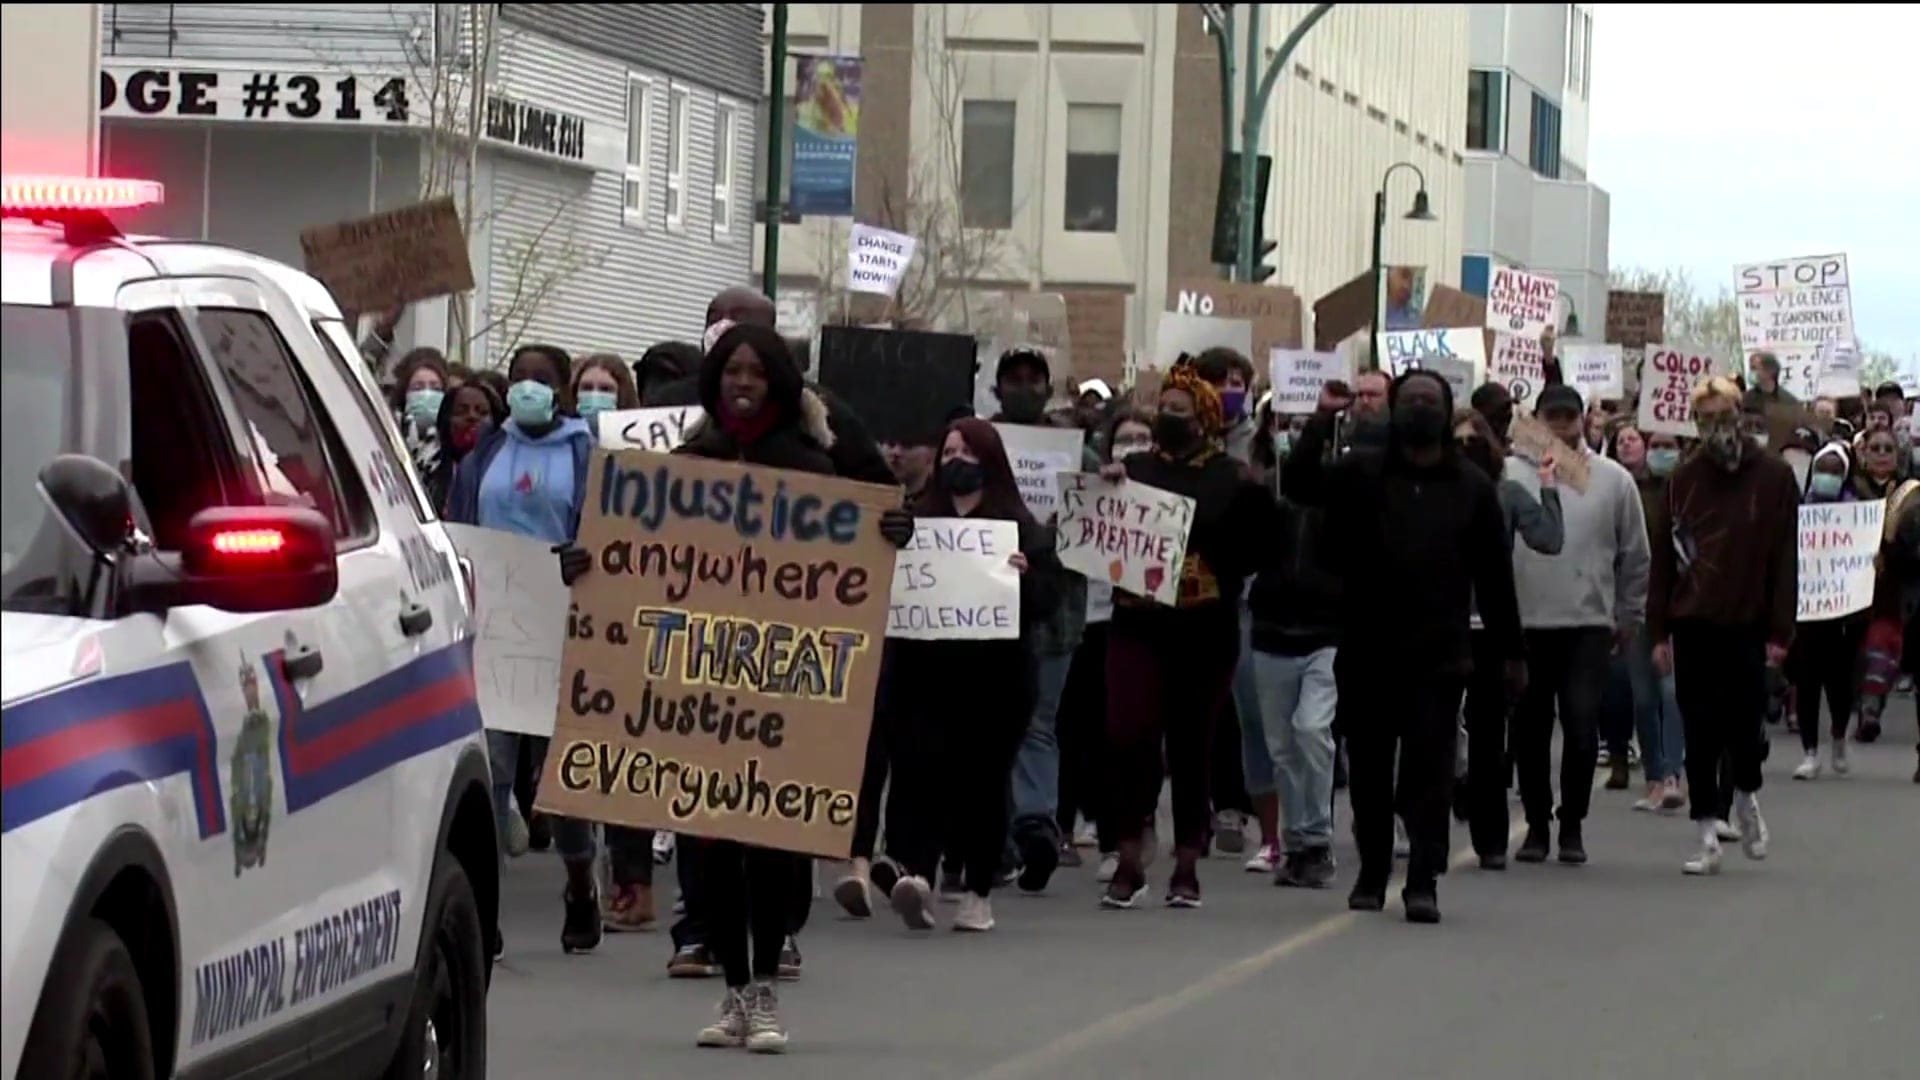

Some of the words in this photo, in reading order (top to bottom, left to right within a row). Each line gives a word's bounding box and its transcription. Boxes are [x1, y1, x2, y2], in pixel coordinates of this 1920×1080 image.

[243, 73, 410, 121] #314
[518, 103, 557, 153] LODGE
[857, 234, 904, 256] CHANGE
[858, 254, 899, 271] STARTS
[1742, 260, 1840, 289] STOP
[1494, 270, 1556, 300] ALWAYS
[1774, 289, 1843, 307] VIOLENCE
[1492, 301, 1546, 322] RACISM
[1386, 328, 1453, 360] BLACK
[1765, 325, 1843, 343] PREJUDICE
[1653, 351, 1713, 376] COLOR
[1651, 387, 1690, 405] NOT
[1668, 375, 1688, 390] IS
[621, 407, 688, 451] SAY
[1017, 458, 1046, 471] STOP
[1095, 494, 1151, 525] CAN'T
[1075, 517, 1174, 564] BREATHE
[602, 539, 870, 607] anywhere
[899, 562, 937, 591] IS
[568, 603, 594, 641] is
[606, 618, 628, 645] a
[634, 605, 869, 702] THREAT
[570, 669, 615, 717] to
[624, 682, 785, 749] justice
[558, 740, 859, 828] everywhere
[191, 935, 285, 1049] MUNICIPAL
[289, 887, 402, 1007] ENFORCEMENT
